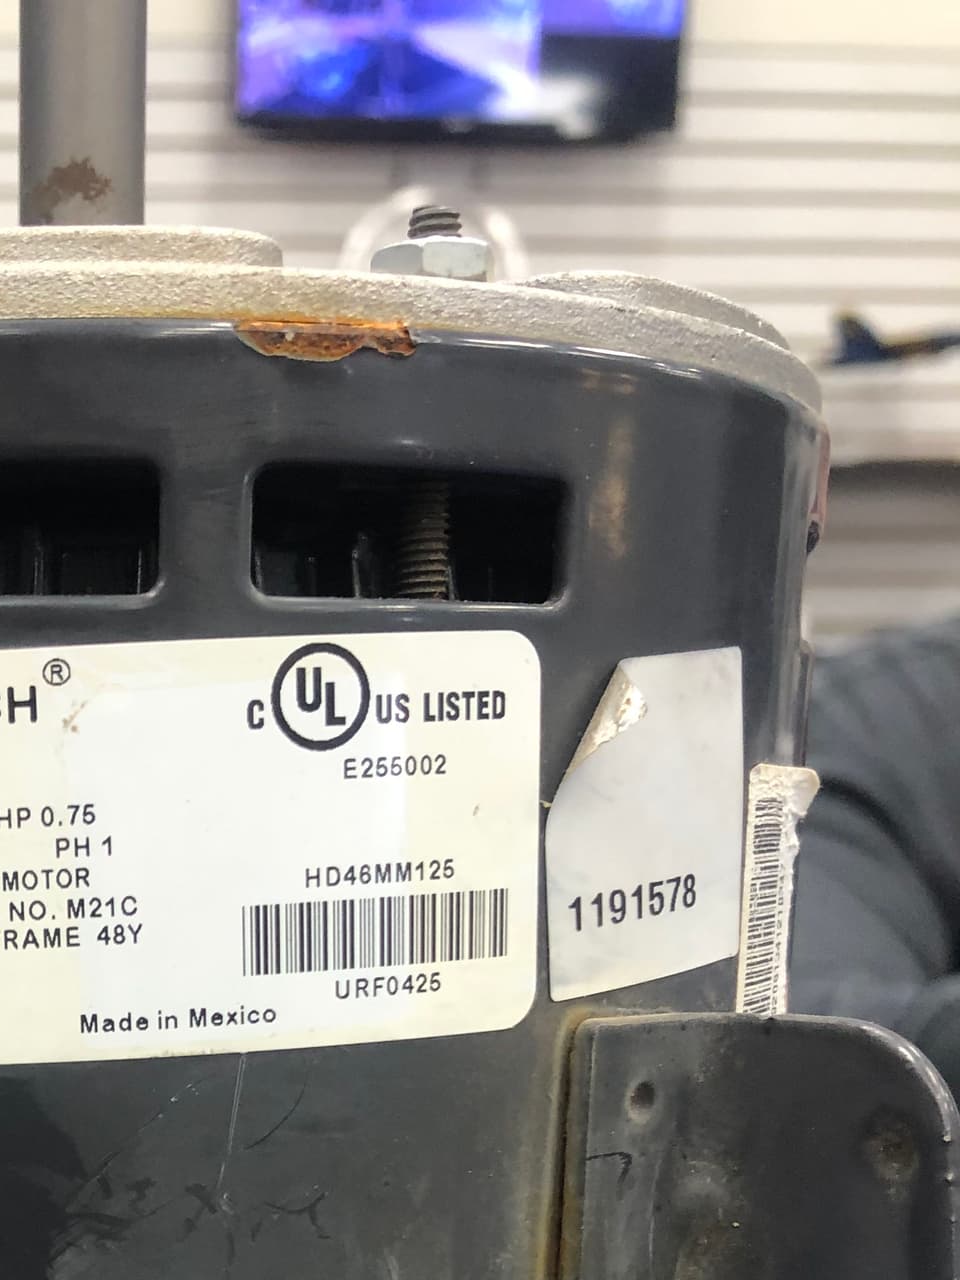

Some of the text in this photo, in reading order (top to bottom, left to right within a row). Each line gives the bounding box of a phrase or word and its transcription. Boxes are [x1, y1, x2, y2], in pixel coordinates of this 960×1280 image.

[246, 699, 265, 730] C
[375, 693, 410, 724] US
[423, 689, 506, 723] LISTED
[343, 753, 447, 780] E255002
[40, 803, 96, 828] 0.75
[55, 836, 91, 859] PH
[101, 835, 112, 857] 1
[1, 867, 90, 892] MOTOR
[305, 858, 455, 889] HD46MM125
[9, 899, 56, 922] NO.
[66, 895, 138, 920] M21C
[568, 873, 697, 932] 1191578
[96, 923, 143, 946] 48Y
[335, 971, 441, 1000] URF0425
[80, 1004, 277, 1034] Made in Mexico
